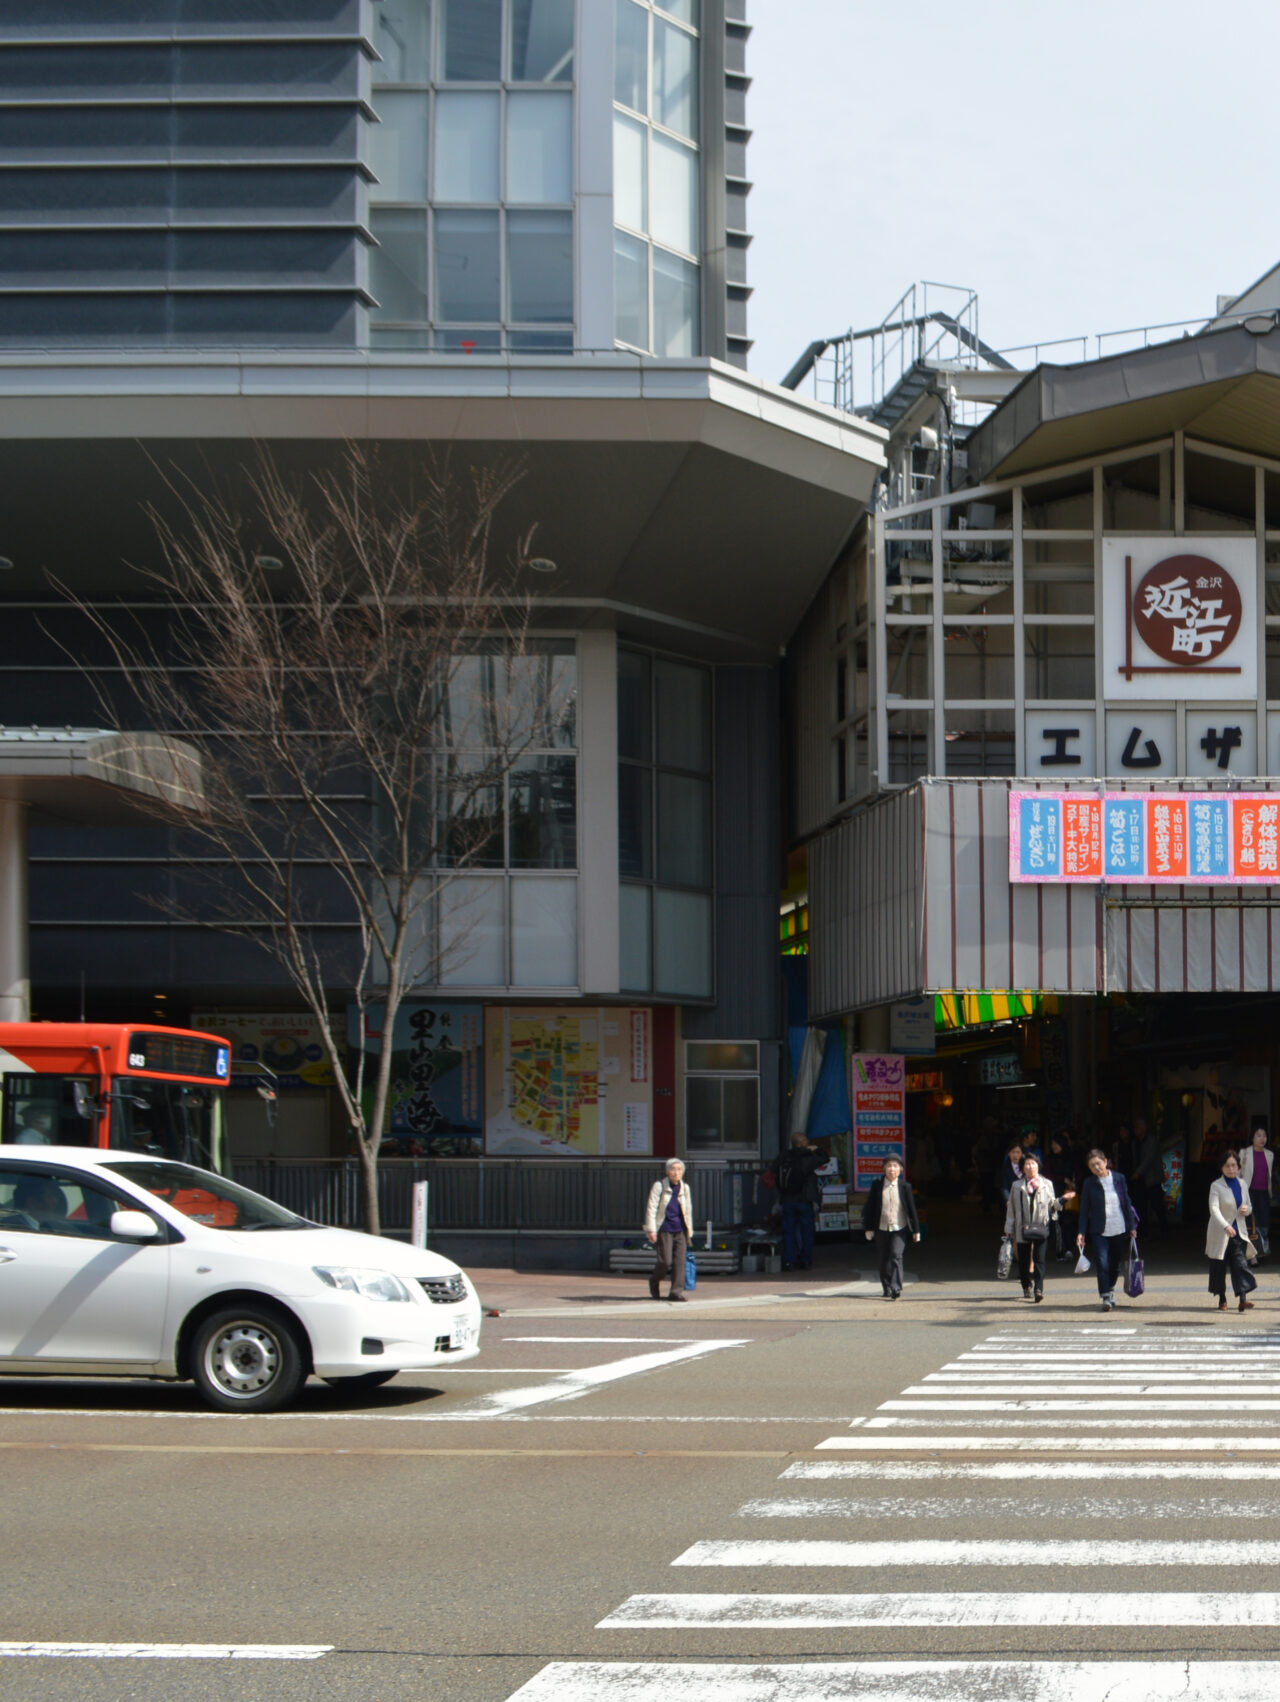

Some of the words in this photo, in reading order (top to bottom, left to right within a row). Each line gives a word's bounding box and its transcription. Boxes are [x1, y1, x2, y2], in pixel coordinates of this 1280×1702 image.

[1196, 576, 1223, 589] 金沢
[1142, 576, 1232, 657] 近江町
[1067, 805, 1078, 873] ステーキ大特売
[1079, 805, 1090, 872] 国産サーロイン
[1258, 805, 1278, 871] 解体特売
